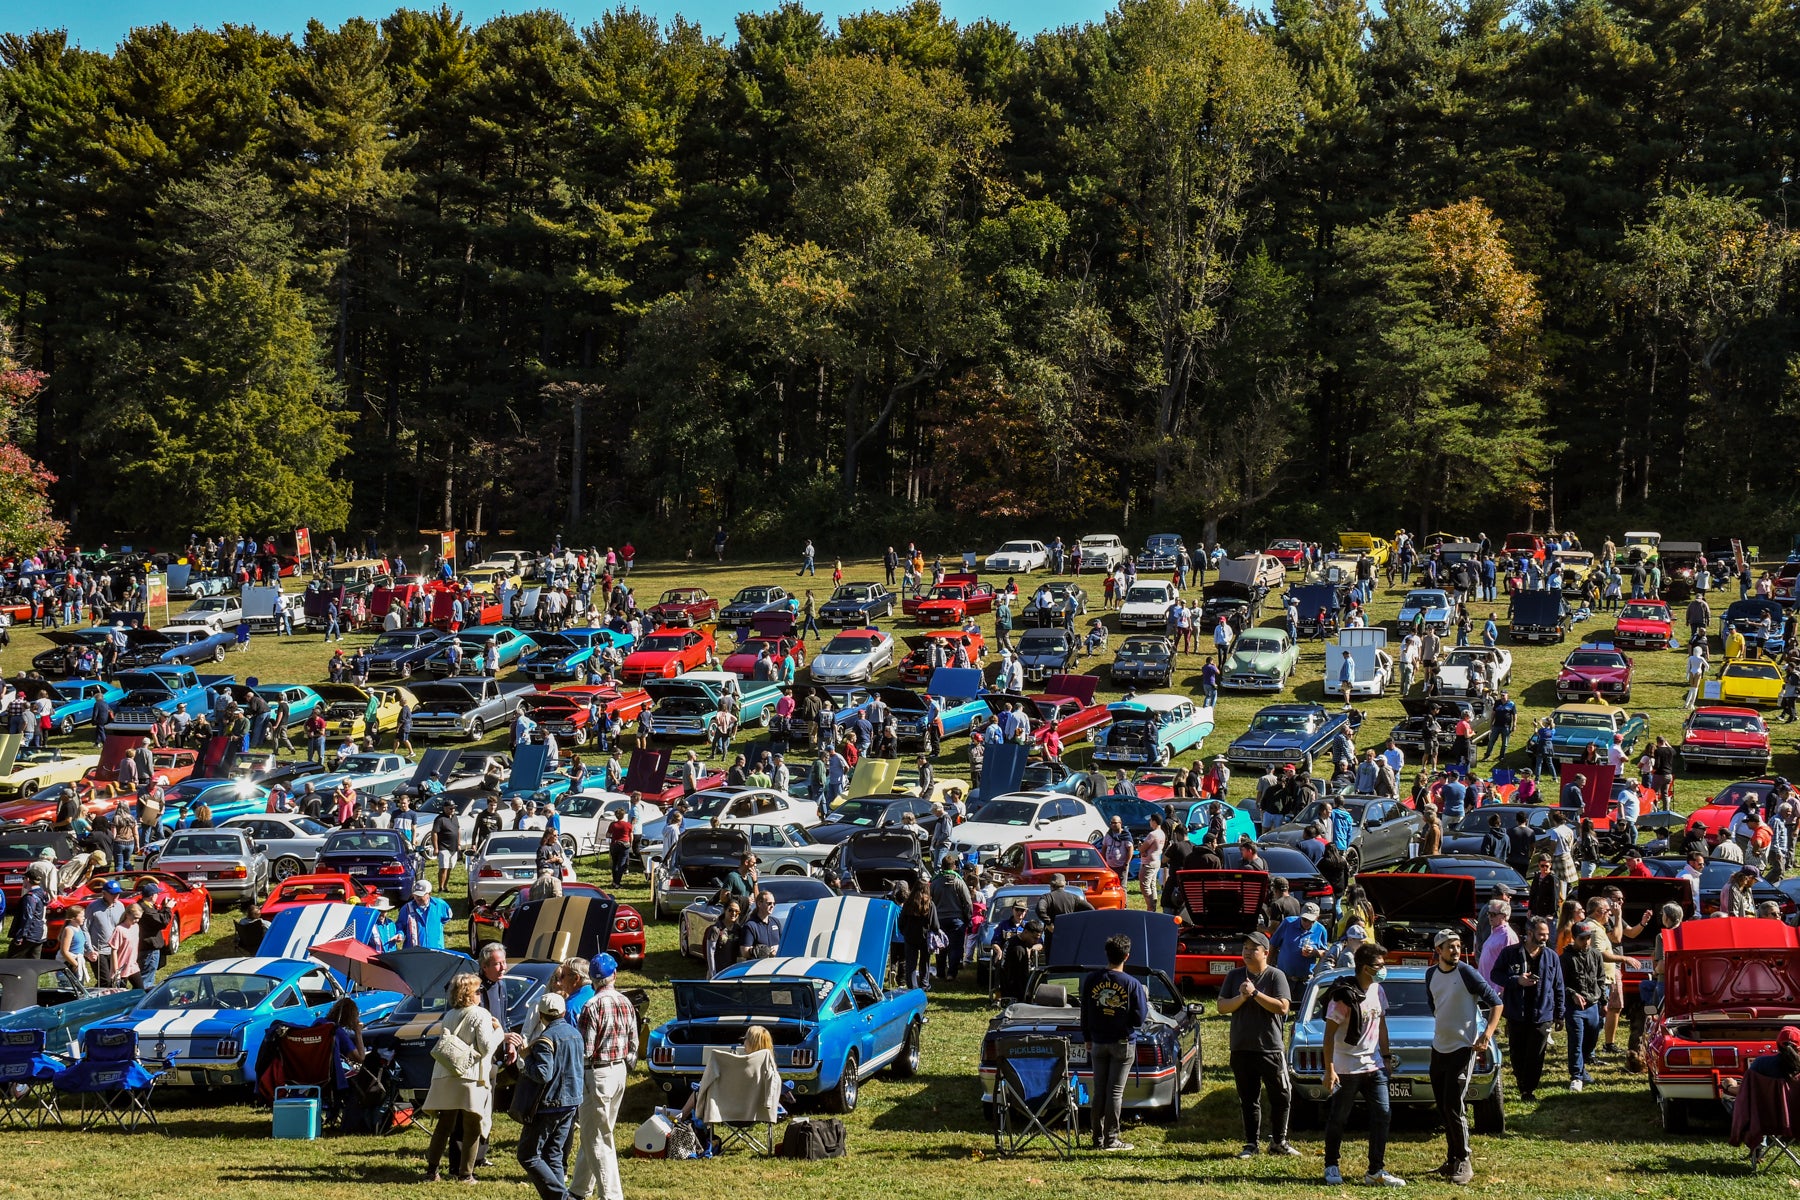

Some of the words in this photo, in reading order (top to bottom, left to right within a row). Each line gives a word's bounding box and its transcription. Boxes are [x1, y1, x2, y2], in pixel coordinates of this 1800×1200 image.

[1091, 981, 1111, 995] HIGH
[1112, 982, 1128, 999] DIVE
[1009, 1045, 1055, 1055] PICKLEBALL
